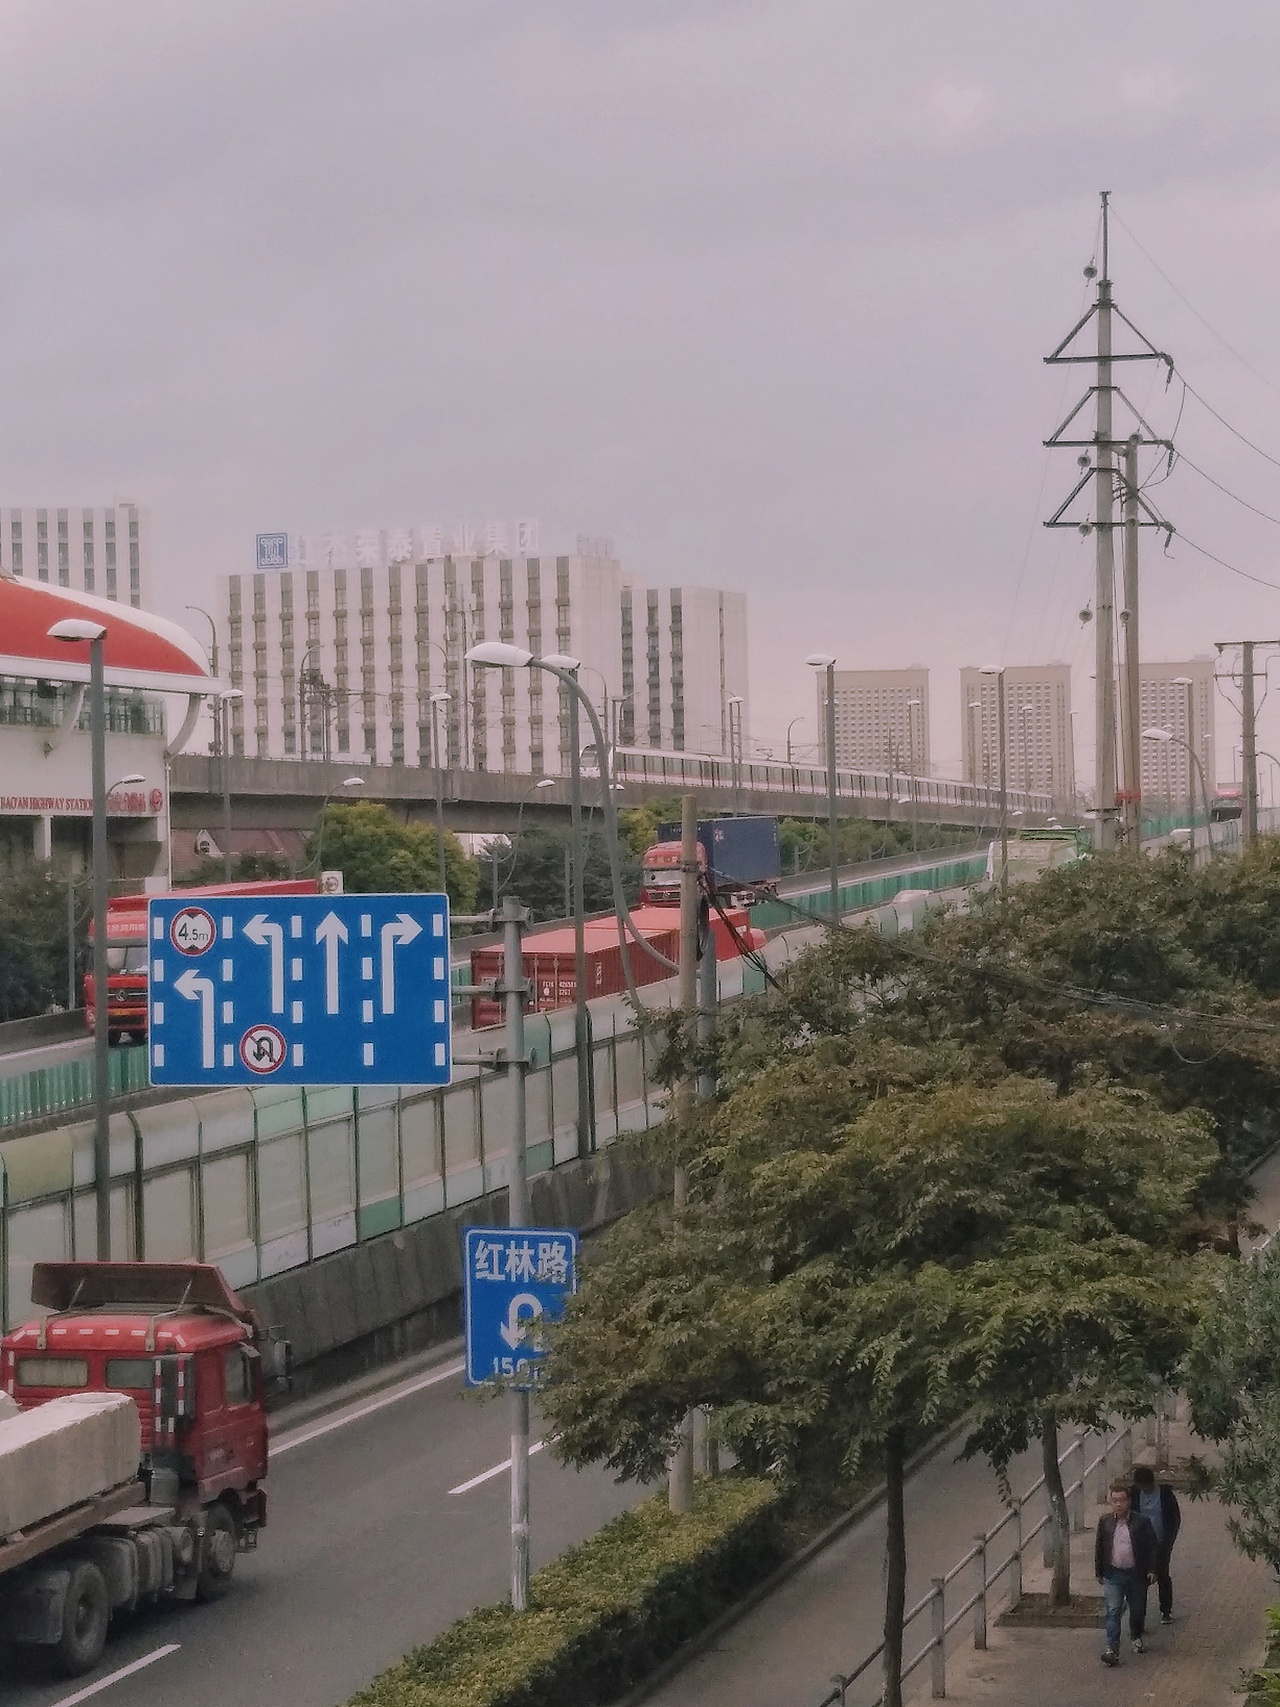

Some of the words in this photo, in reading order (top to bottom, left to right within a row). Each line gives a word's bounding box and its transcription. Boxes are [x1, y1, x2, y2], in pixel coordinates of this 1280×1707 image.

[28, 797, 64, 810] HIGHWAY
[178, 922, 209, 941] 4.5m
[475, 1239, 569, 1283] 红林路
